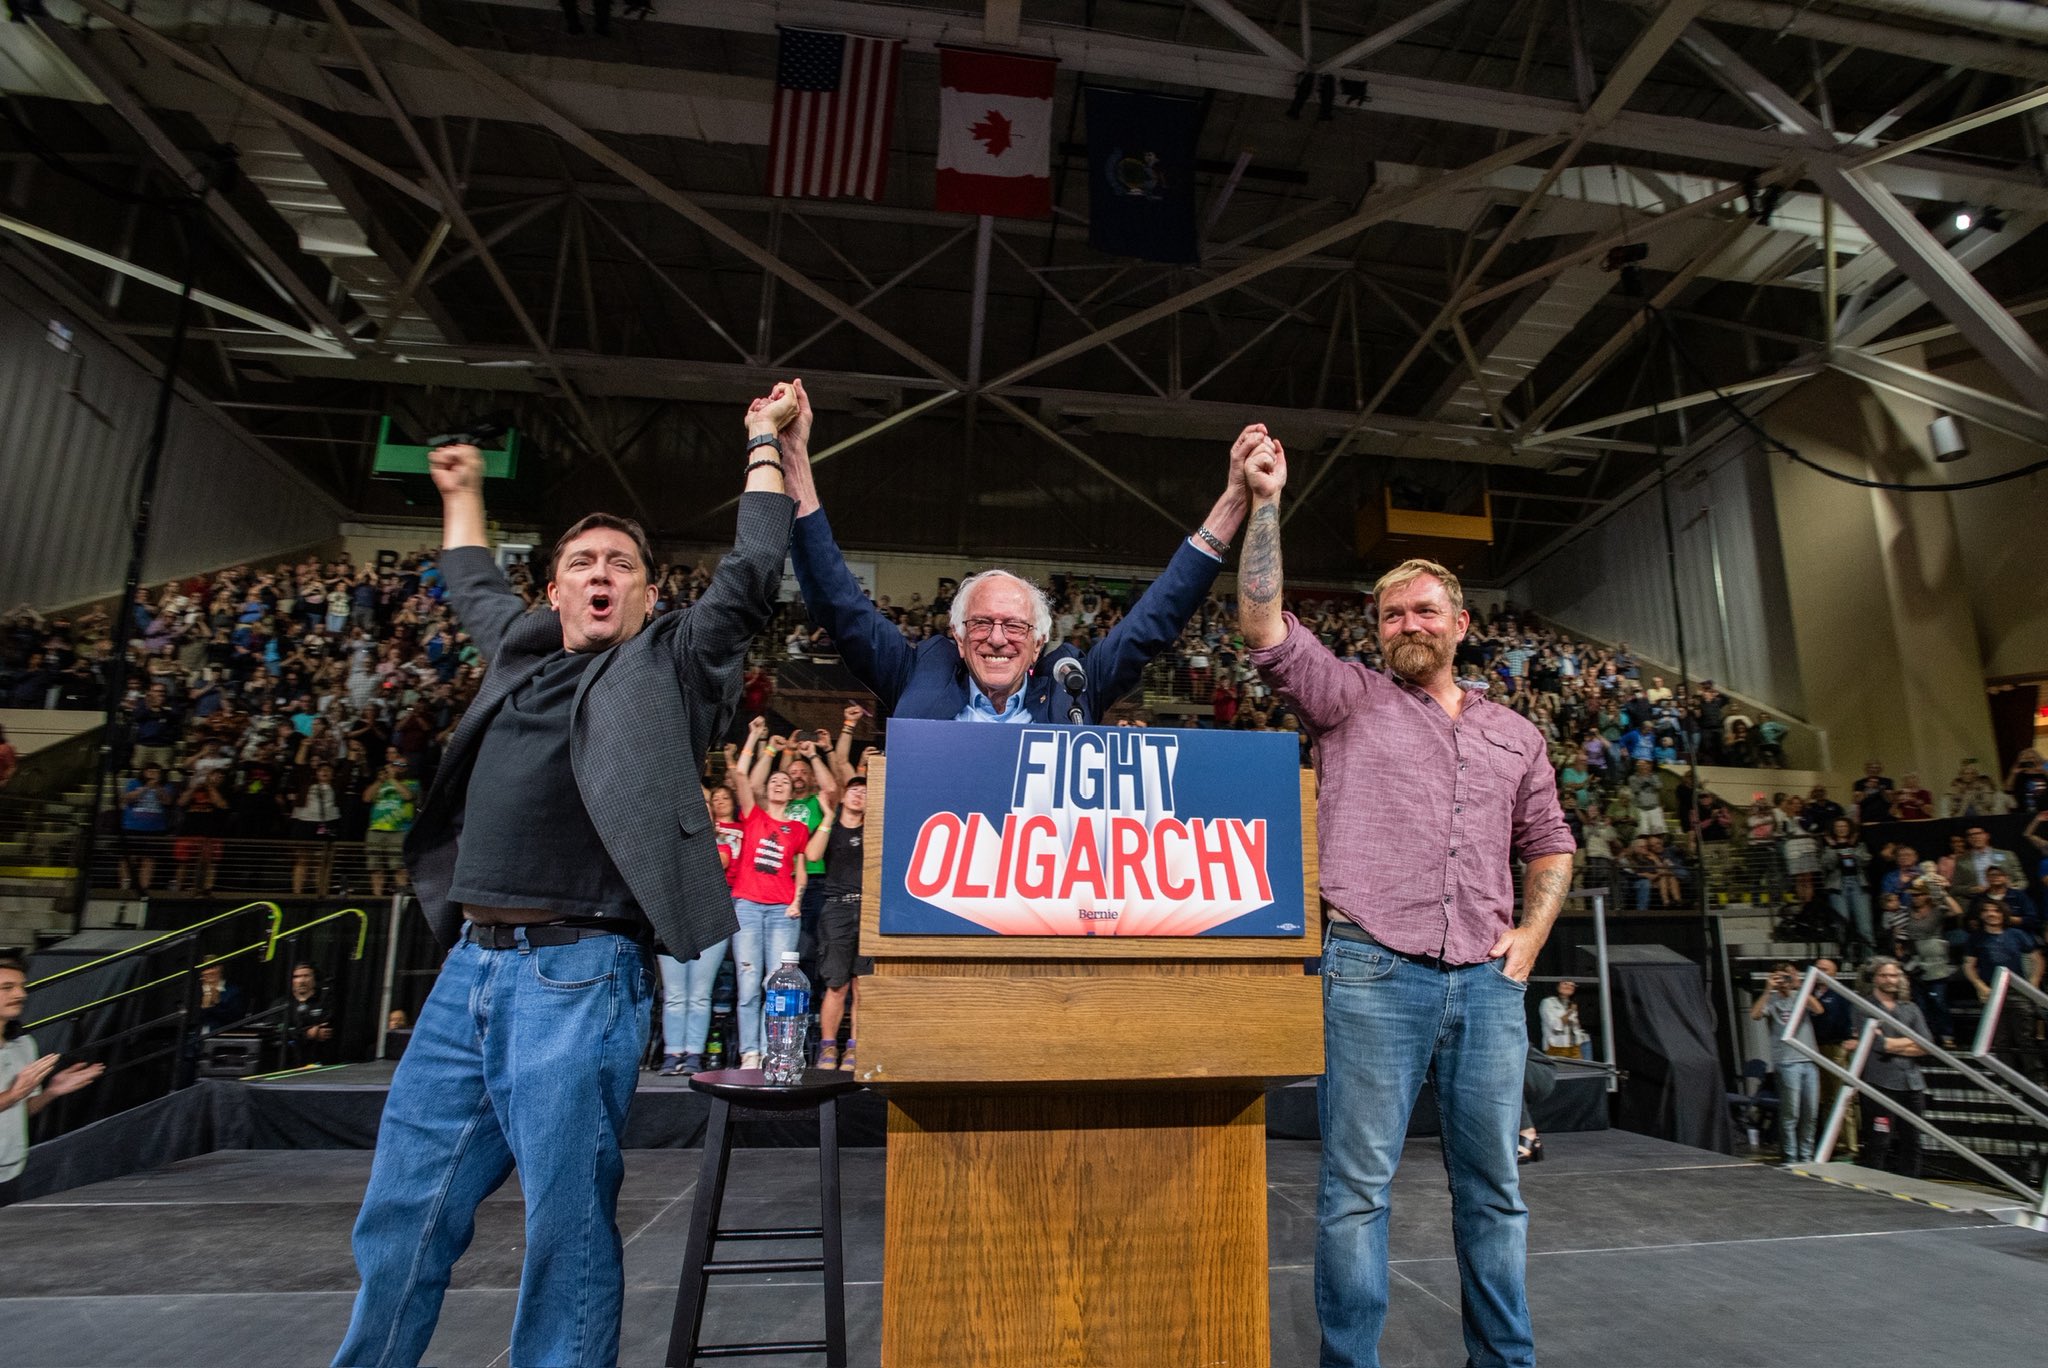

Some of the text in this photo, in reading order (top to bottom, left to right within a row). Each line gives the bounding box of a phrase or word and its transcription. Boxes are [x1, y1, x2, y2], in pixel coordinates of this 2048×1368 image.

[1011, 729, 1179, 812] FIGHT
[906, 812, 1273, 902] OLIGARCHY
[1079, 908, 1118, 921] Bernie
